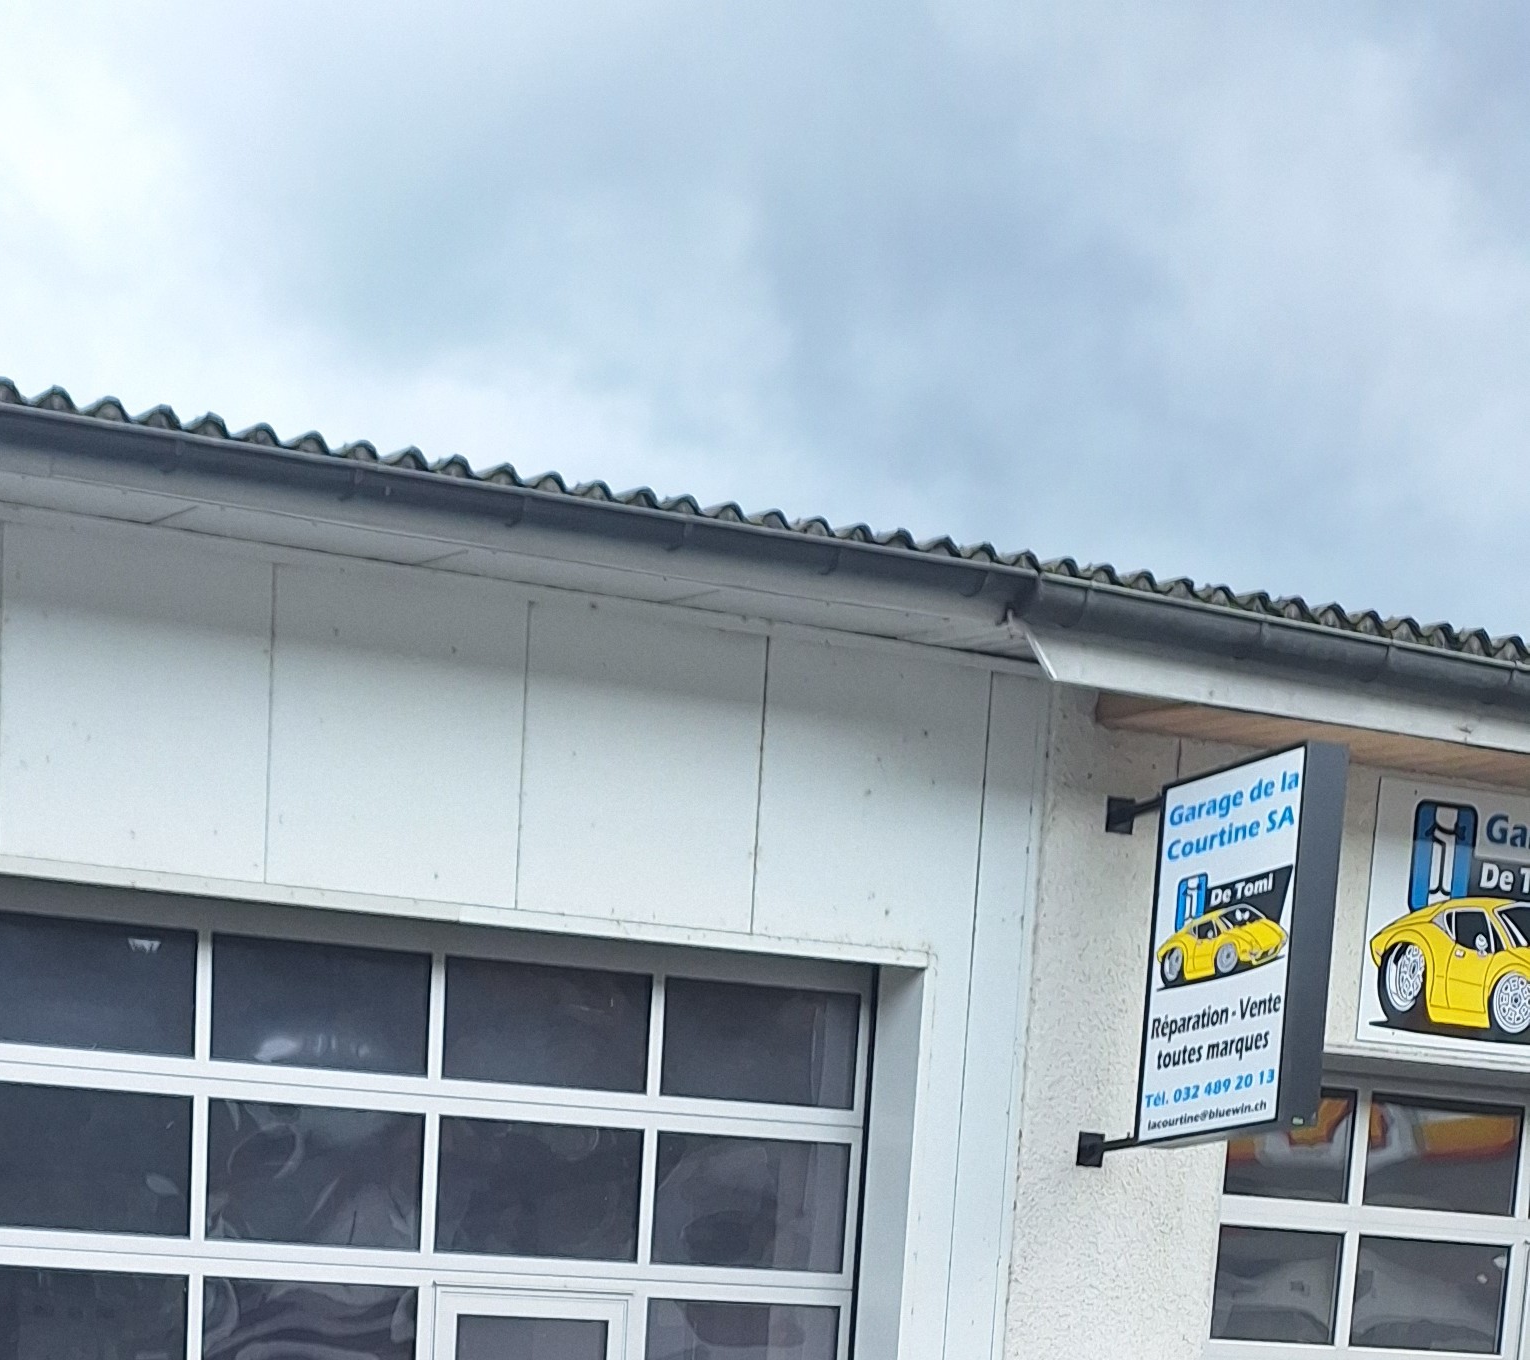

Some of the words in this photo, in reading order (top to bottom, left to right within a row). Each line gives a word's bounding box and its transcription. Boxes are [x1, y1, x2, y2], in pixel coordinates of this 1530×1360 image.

[1169, 790, 1244, 826] Garage
[1250, 778, 1275, 803] de
[1281, 771, 1300, 792] la
[1167, 819, 1261, 860] Courtine
[1266, 806, 1295, 833] SA
[1486, 813, 1530, 848] Ga
[1210, 887, 1231, 907] De
[1479, 862, 1514, 892] De
[1150, 1004, 1229, 1042] Réparation
[1239, 993, 1282, 1021] Vente
[1156, 1043, 1203, 1070] toutes
[1206, 1030, 1270, 1061] marques
[1144, 1091, 1169, 1109] Tél.
[1173, 1084, 1200, 1103] 032
[1204, 1077, 1232, 1096] 489
[1234, 1073, 1253, 1091] 20
[1259, 1068, 1275, 1085] 13
[1147, 1099, 1267, 1131] lacourtine@bluewin.ch
